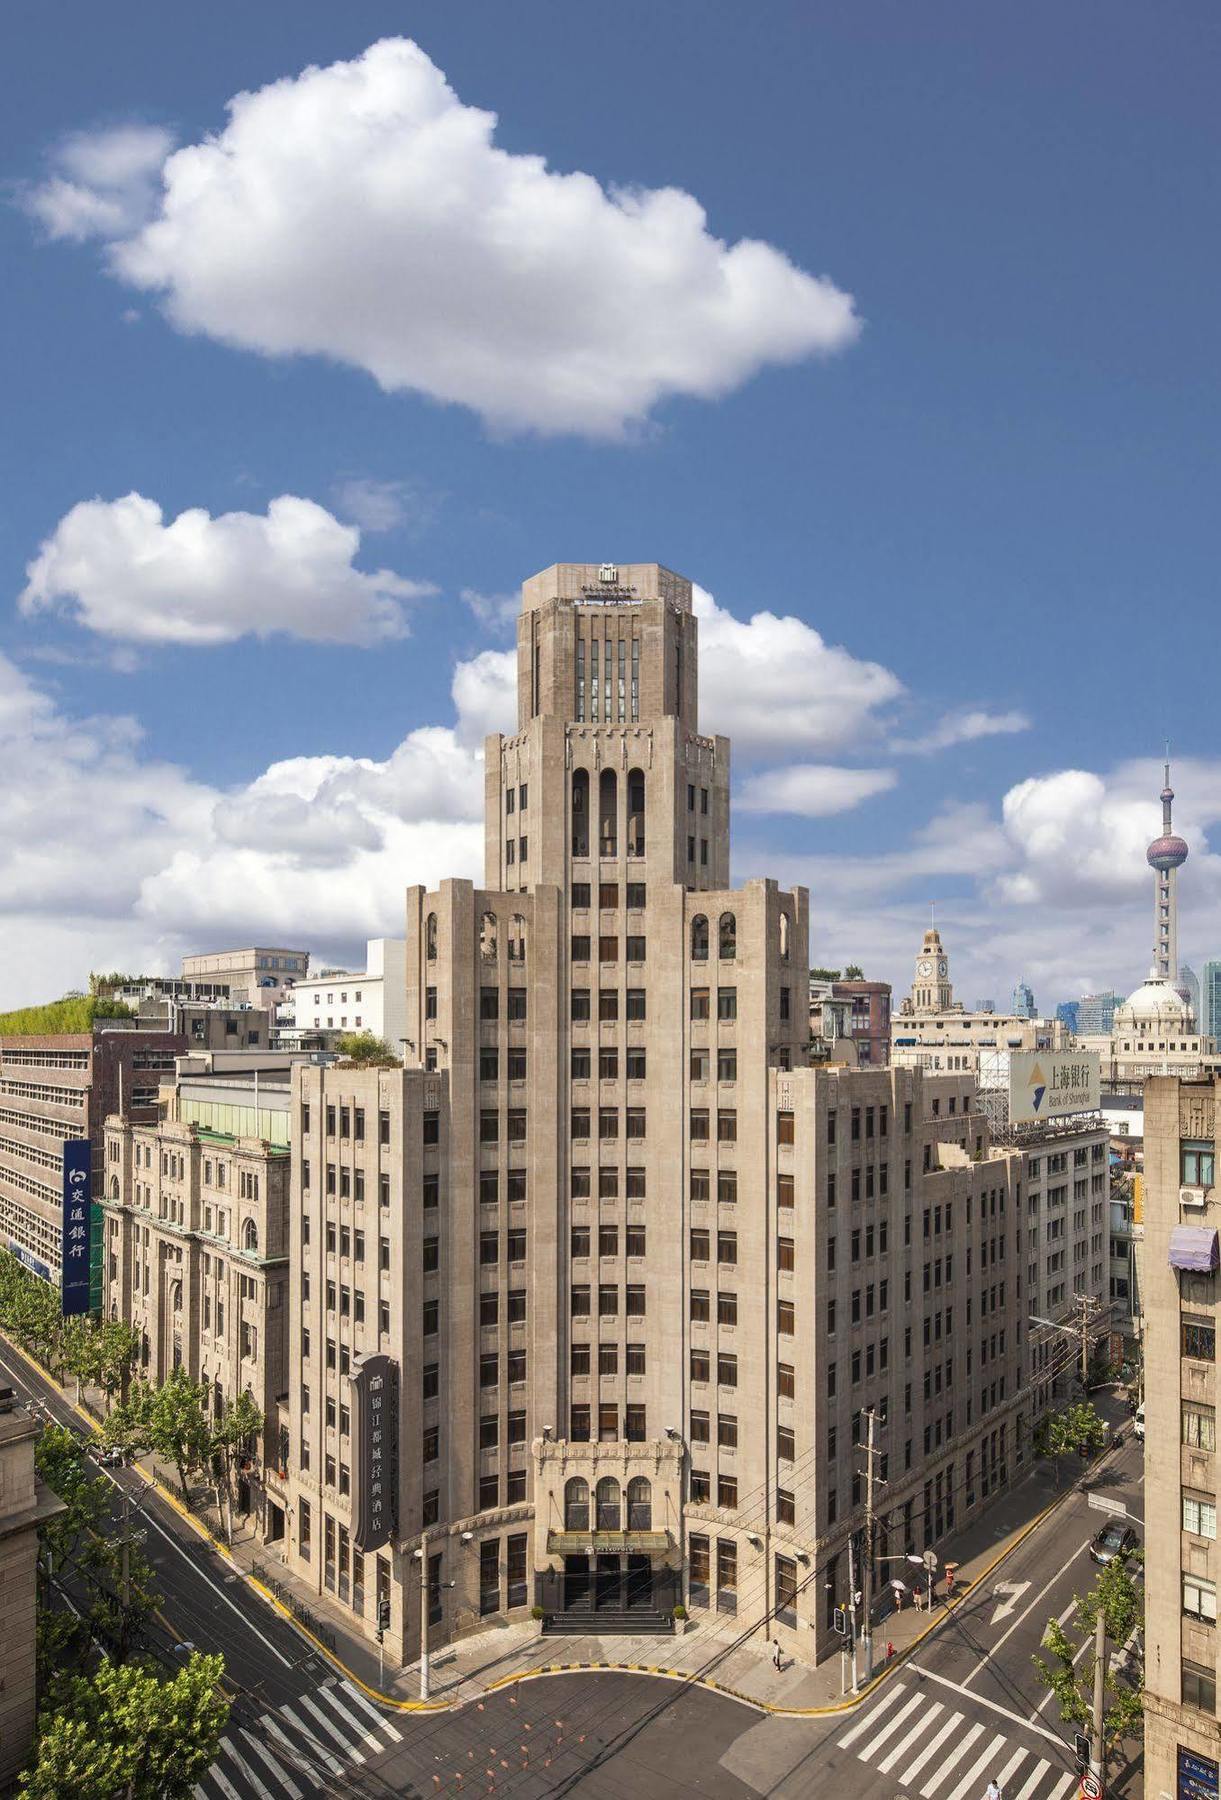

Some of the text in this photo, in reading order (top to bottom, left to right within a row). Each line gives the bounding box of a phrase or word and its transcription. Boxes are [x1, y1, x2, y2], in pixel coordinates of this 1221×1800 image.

[1049, 1064, 1090, 1090] 上海银行
[1049, 1094, 1062, 1107] Bank
[1069, 1091, 1090, 1106] Shanghai
[69, 1189, 86, 1257] 交通銀行
